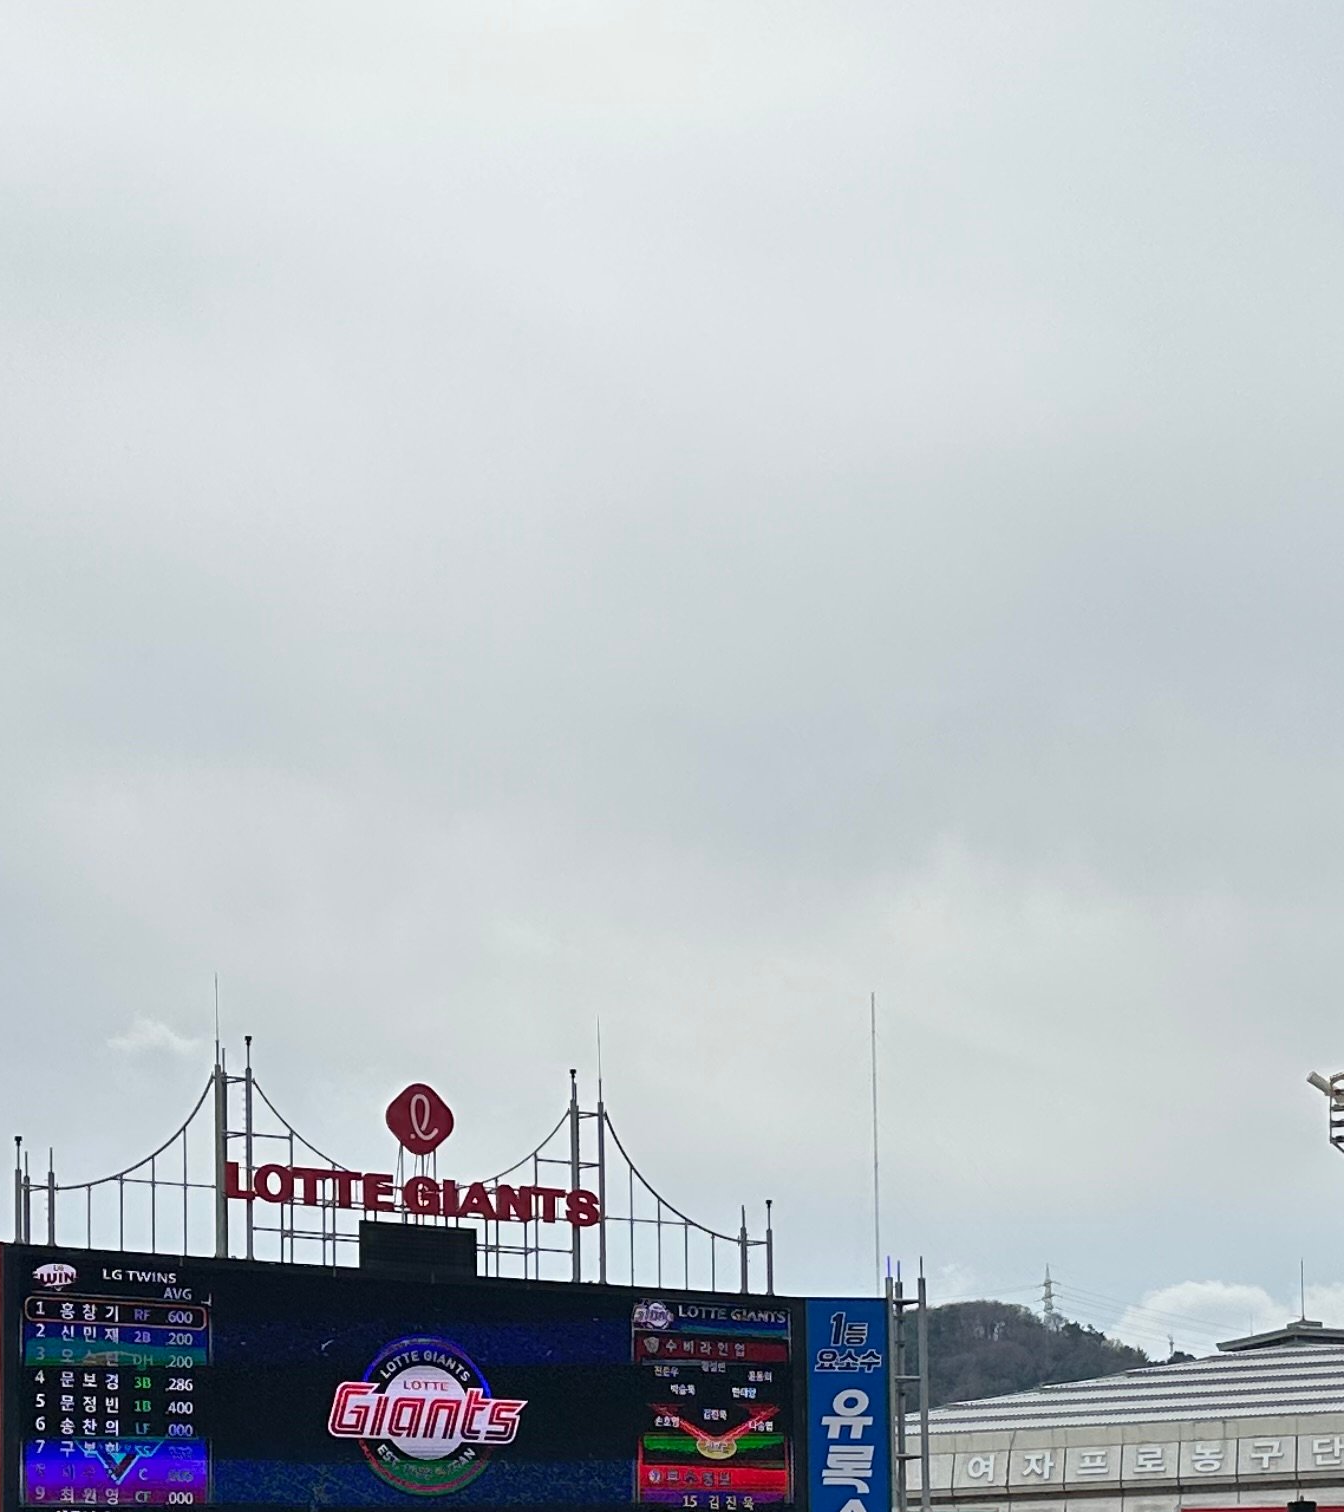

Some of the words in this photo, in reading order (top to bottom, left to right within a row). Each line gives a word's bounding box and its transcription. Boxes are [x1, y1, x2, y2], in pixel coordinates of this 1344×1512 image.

[226, 1162, 395, 1212] LOTTE
[404, 1175, 600, 1228] GIANTS
[102, 1268, 123, 1281] LG
[126, 1270, 177, 1285] TWINS
[163, 1287, 192, 1300] AVG
[36, 1301, 46, 1315] 1
[678, 1305, 727, 1320] LOTTE
[730, 1306, 786, 1323] GIANTS
[35, 1324, 46, 1338] 2
[60, 1325, 119, 1344] 신민재
[830, 1311, 868, 1348] 1등
[35, 1346, 46, 1360] 3
[665, 1338, 745, 1358] 수비라인업
[379, 1350, 420, 1379] LOTTE
[423, 1350, 471, 1382] GIANTS
[814, 1348, 882, 1373] 요소수
[34, 1370, 45, 1384] 4
[134, 1377, 151, 1389] 3B
[403, 1380, 449, 1392] LOTTE
[35, 1393, 45, 1407] 5
[328, 1381, 528, 1445] Giants
[35, 1416, 46, 1431] 6
[35, 1440, 45, 1453] 7
[35, 1487, 45, 1500] 9
[682, 1494, 698, 1507] 15
